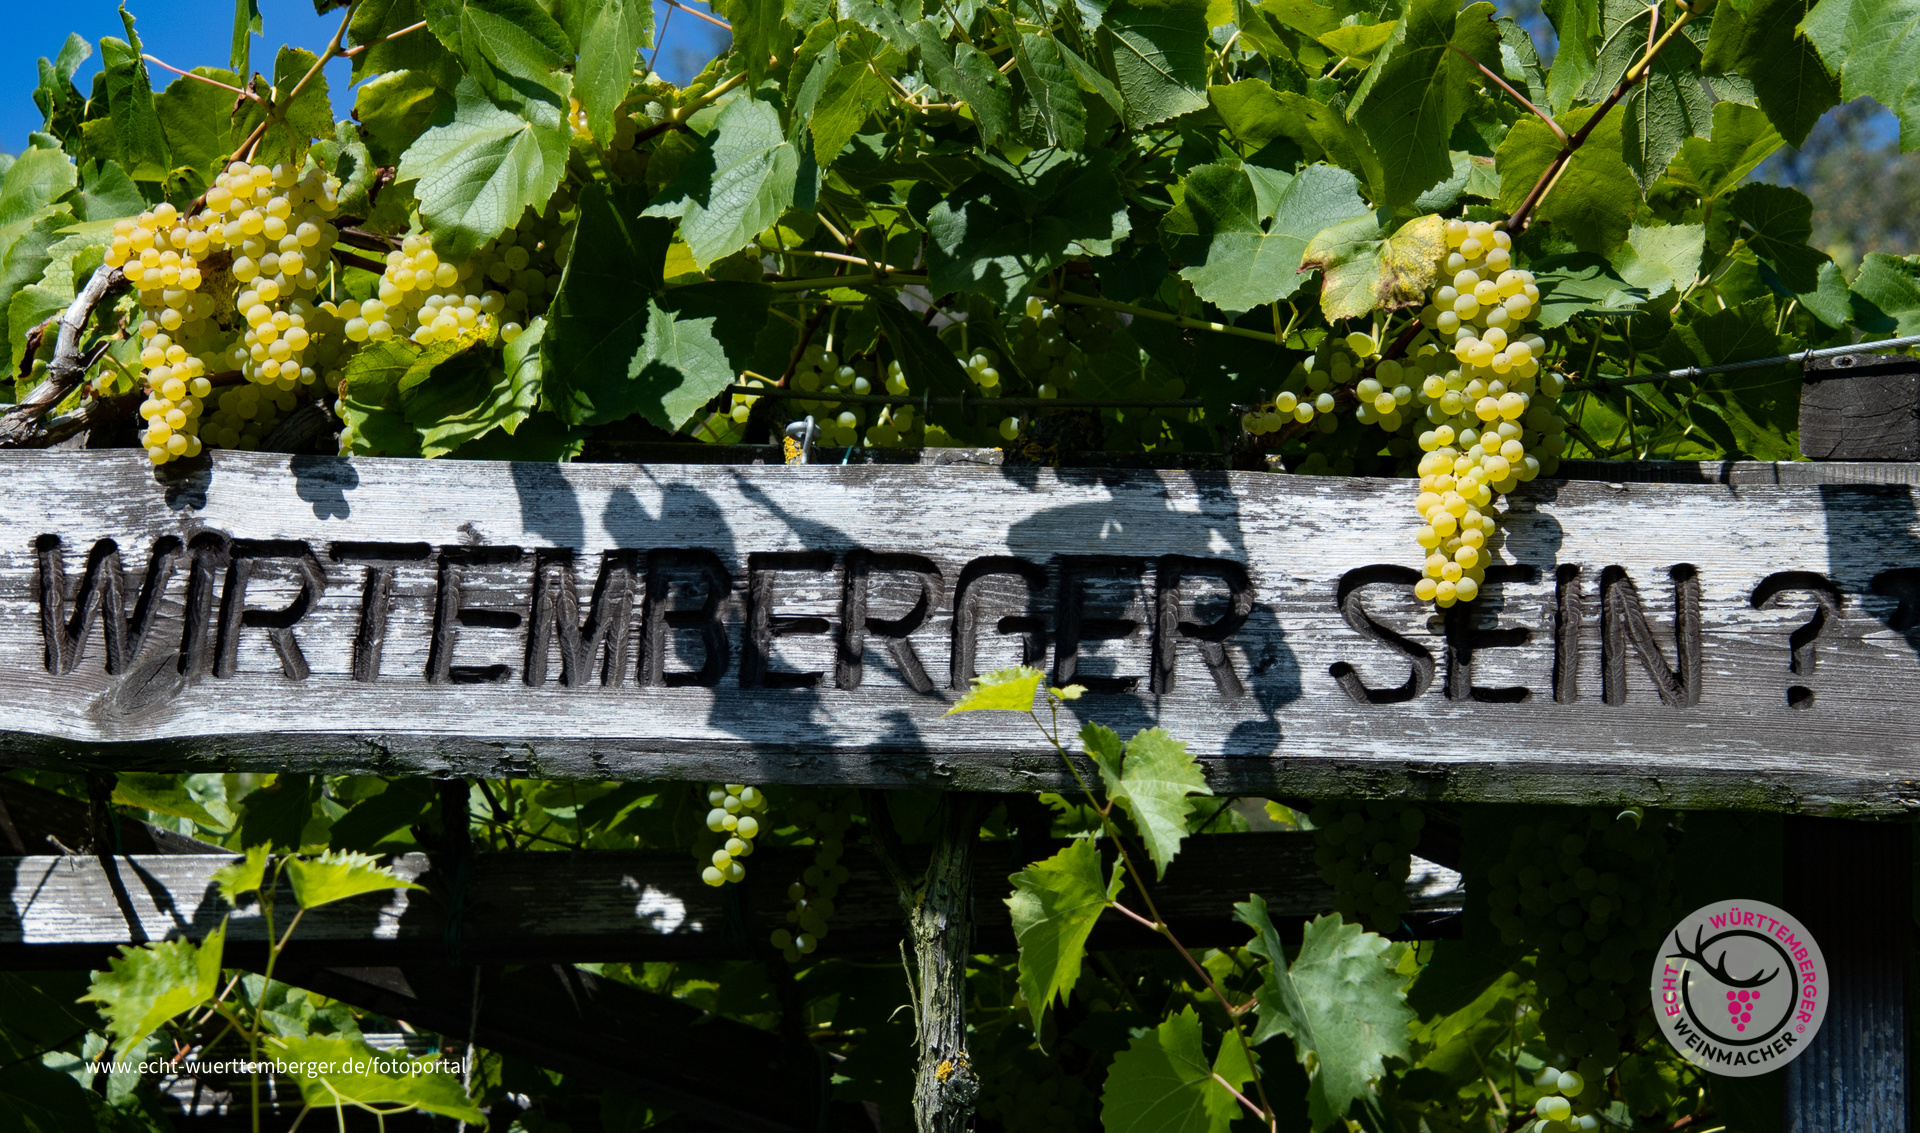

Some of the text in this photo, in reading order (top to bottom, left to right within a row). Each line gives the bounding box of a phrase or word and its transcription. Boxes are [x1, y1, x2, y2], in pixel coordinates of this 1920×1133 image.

[35, 533, 1255, 698] WIRTEMBERGER
[1328, 562, 1702, 708] SEIN
[1750, 570, 1844, 710] ?
